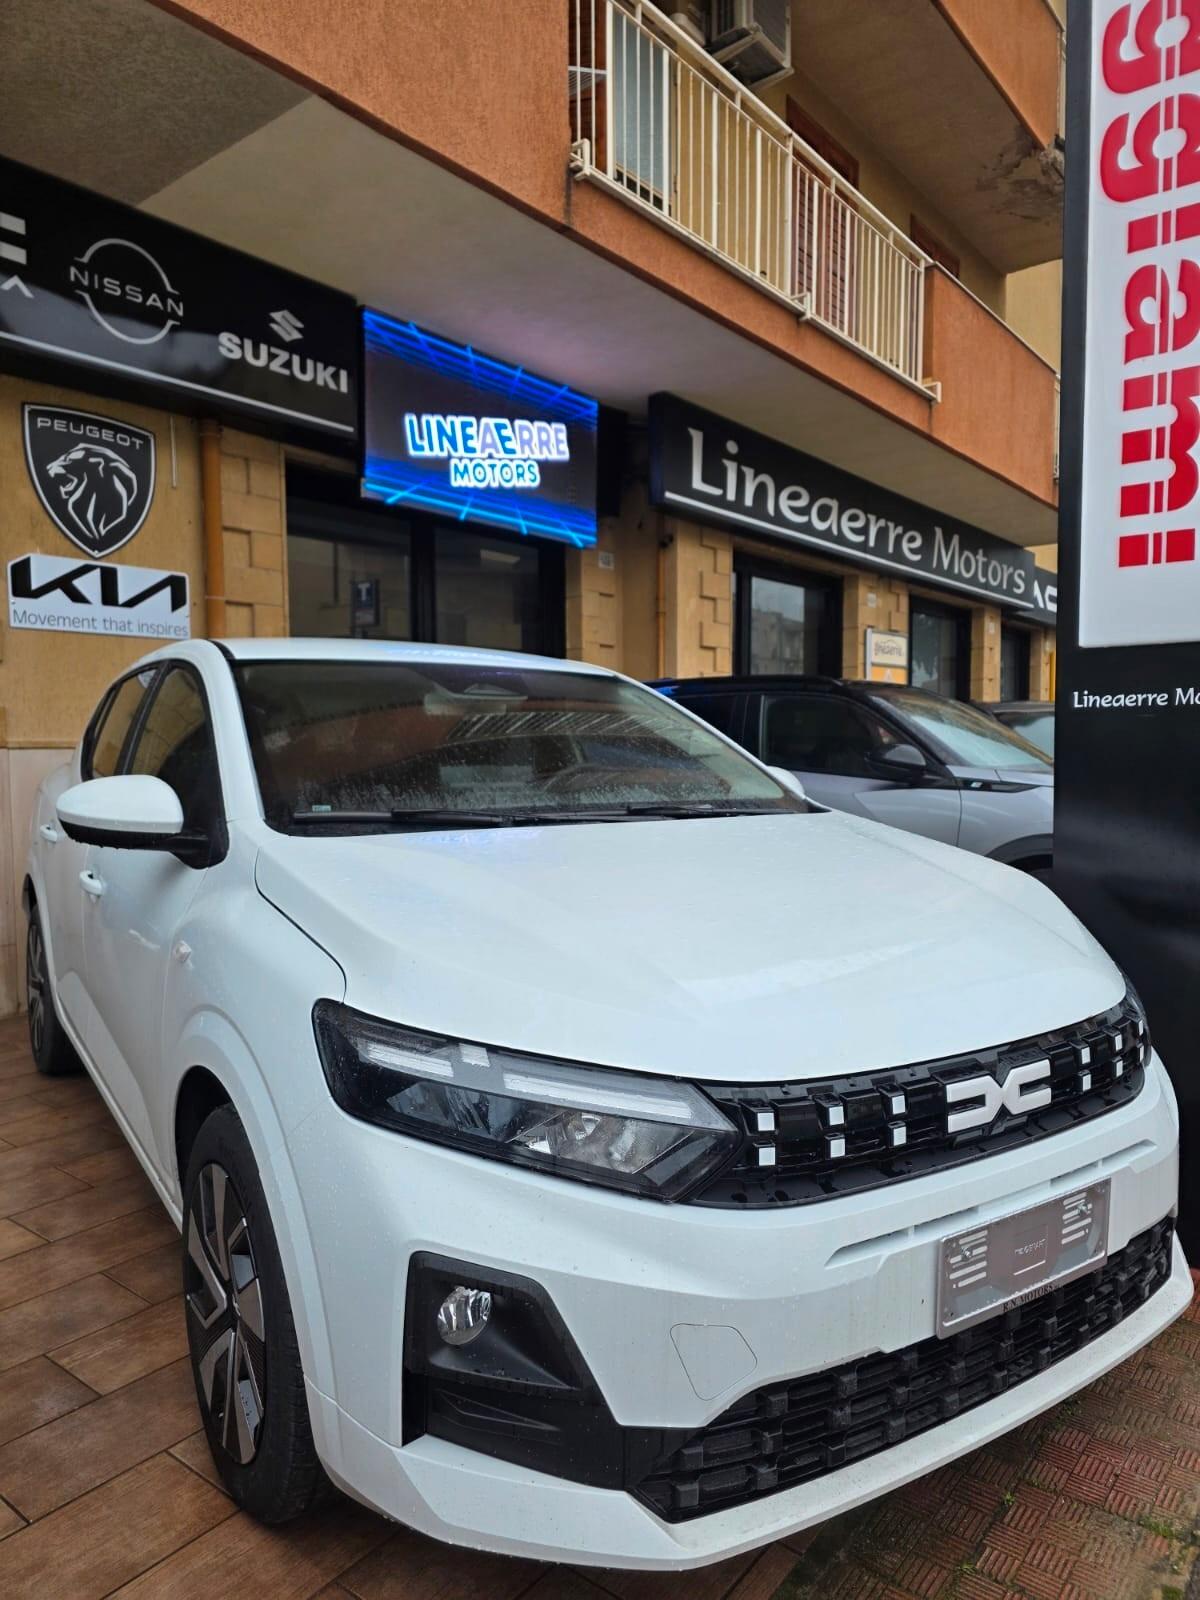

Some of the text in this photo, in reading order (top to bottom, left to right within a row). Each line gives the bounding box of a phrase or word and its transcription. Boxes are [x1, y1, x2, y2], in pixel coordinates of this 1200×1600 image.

[70, 265, 184, 317] NISSAN
[218, 332, 348, 394] SUZUKI
[37, 417, 144, 450] PEUGEOT
[452, 460, 539, 486] MOTORS
[688, 427, 1026, 595] Lineaerre Motors
[10, 556, 187, 613] KIA
[13, 609, 188, 638] Movement that inspires
[1073, 690, 1169, 708] Lineaerre
